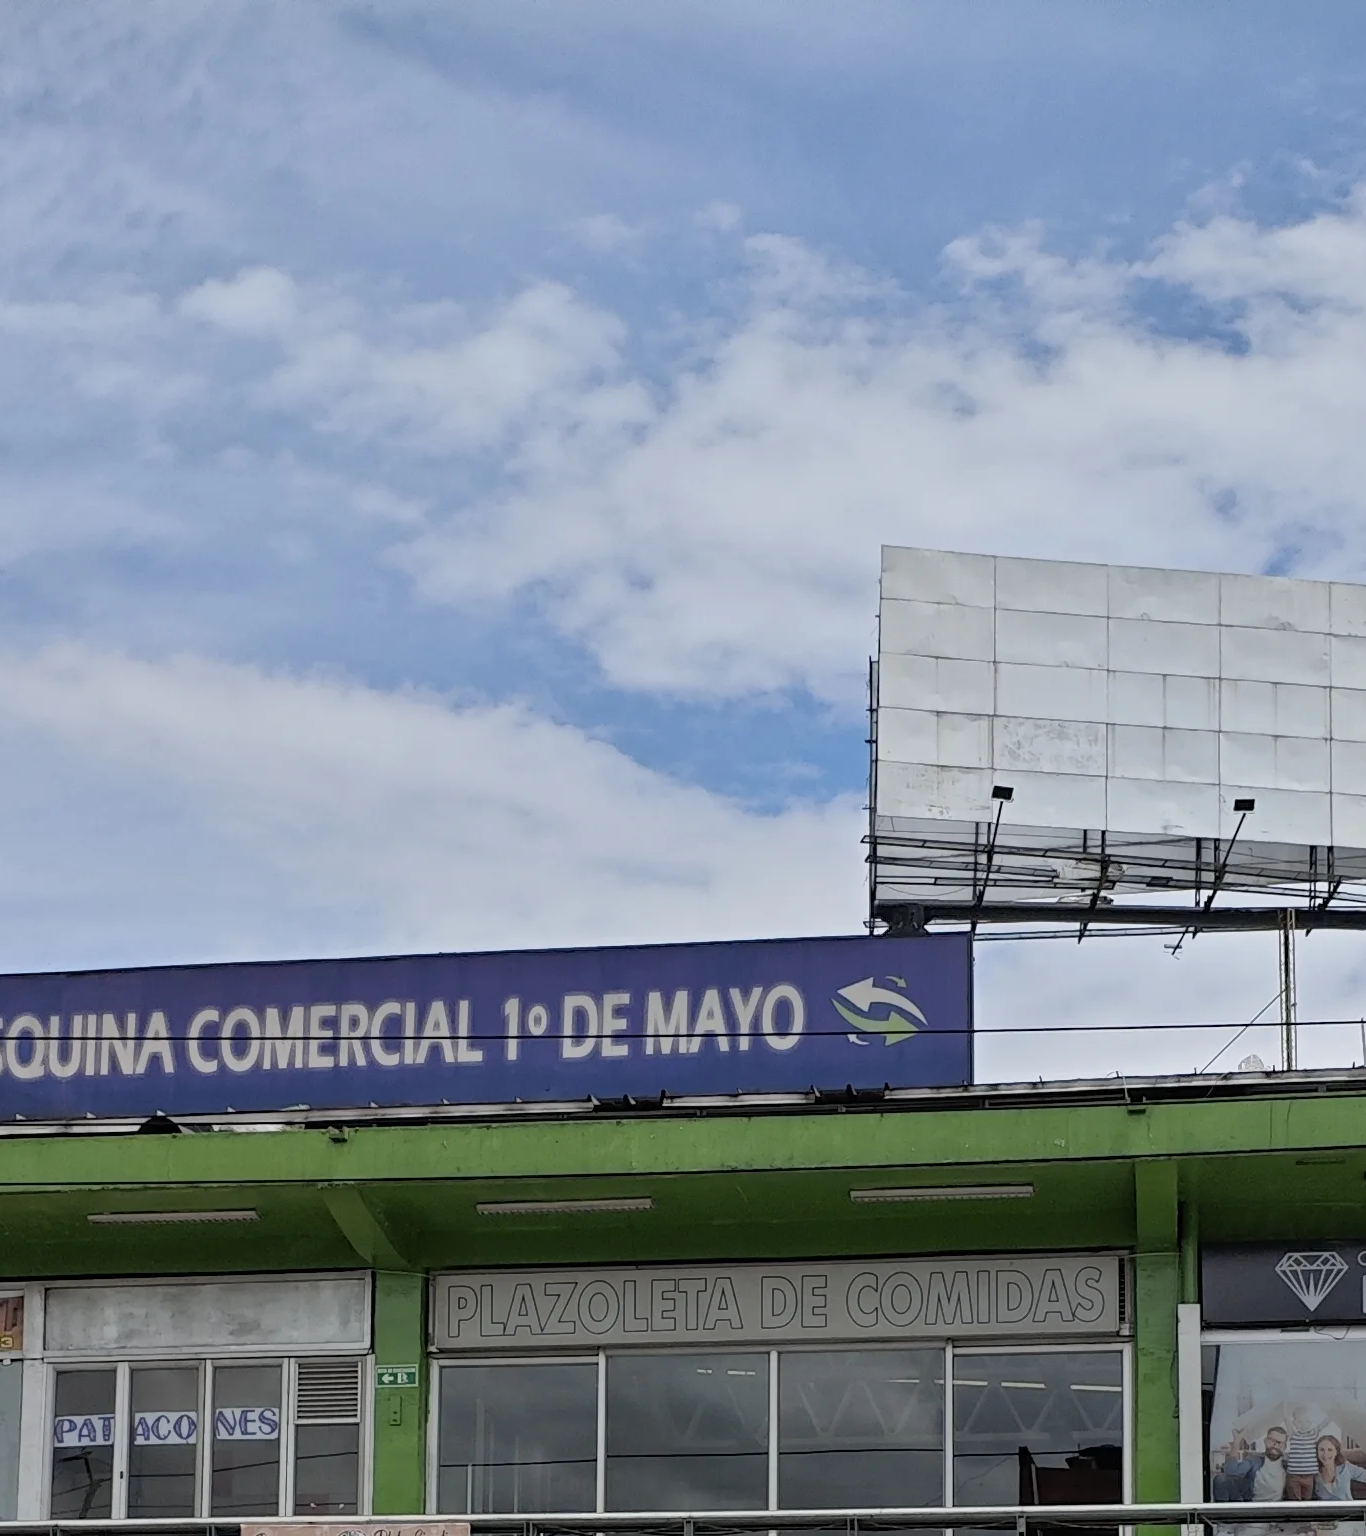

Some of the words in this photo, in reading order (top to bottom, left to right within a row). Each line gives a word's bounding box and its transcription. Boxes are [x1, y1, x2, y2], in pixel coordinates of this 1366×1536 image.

[188, 996, 482, 1075] COMERCIAL
[562, 991, 632, 1060] DE
[645, 983, 805, 1056] MAYO
[446, 1276, 743, 1339] PLAZOLETA
[761, 1274, 828, 1331] DE
[846, 1265, 1105, 1329] COMIDAS
